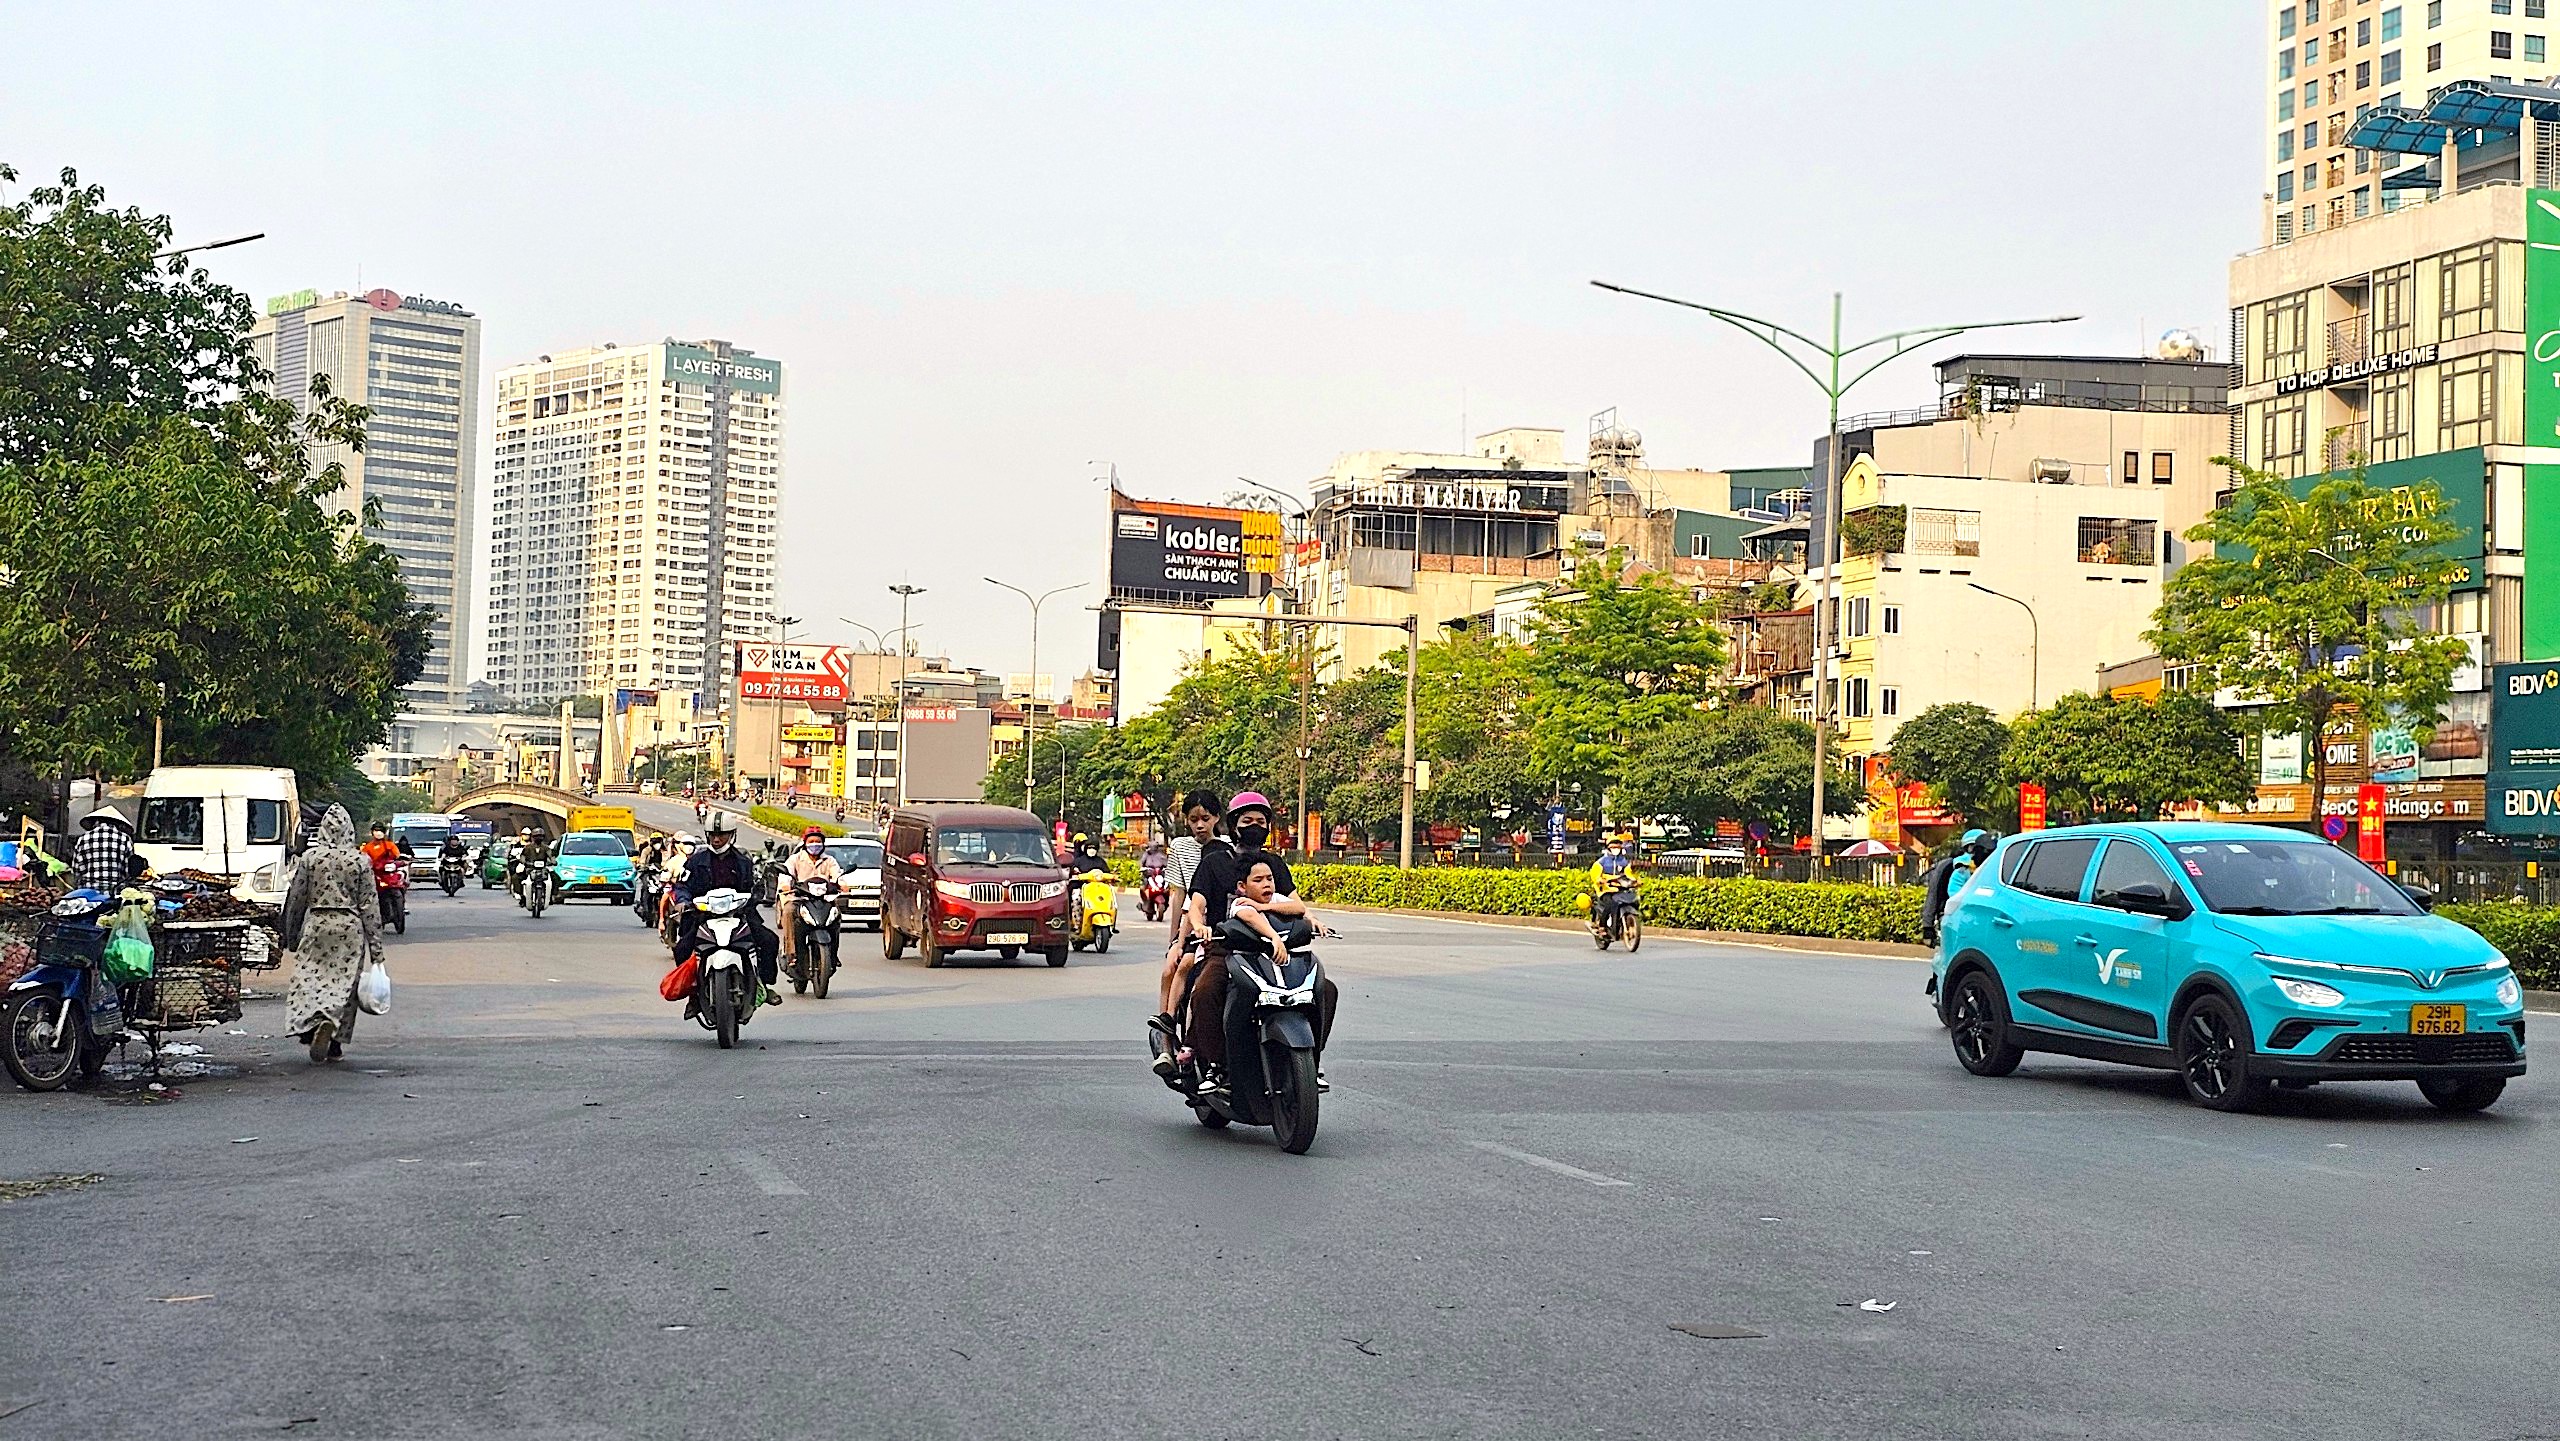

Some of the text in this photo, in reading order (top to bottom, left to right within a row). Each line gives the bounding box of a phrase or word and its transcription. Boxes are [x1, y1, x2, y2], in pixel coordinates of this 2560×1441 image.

[673, 356, 773, 383] LAYER FRESH
[2332, 353, 2388, 381] DELUXE
[2391, 345, 2436, 369] HOME
[1164, 553, 1239, 570] SÀN THẠCH ANH
[1164, 564, 1239, 585] CHUẨN ĐỨC
[772, 649, 801, 660] KIM
[745, 681, 763, 695] 09
[782, 684, 801, 696] 44
[803, 685, 820, 697] 55
[823, 686, 841, 698] 88
[2509, 674, 2546, 696] BIDV
[2505, 789, 2555, 816] BIDV
[2426, 1005, 2451, 1019] 29H
[2417, 1020, 2460, 1034] 976.82
